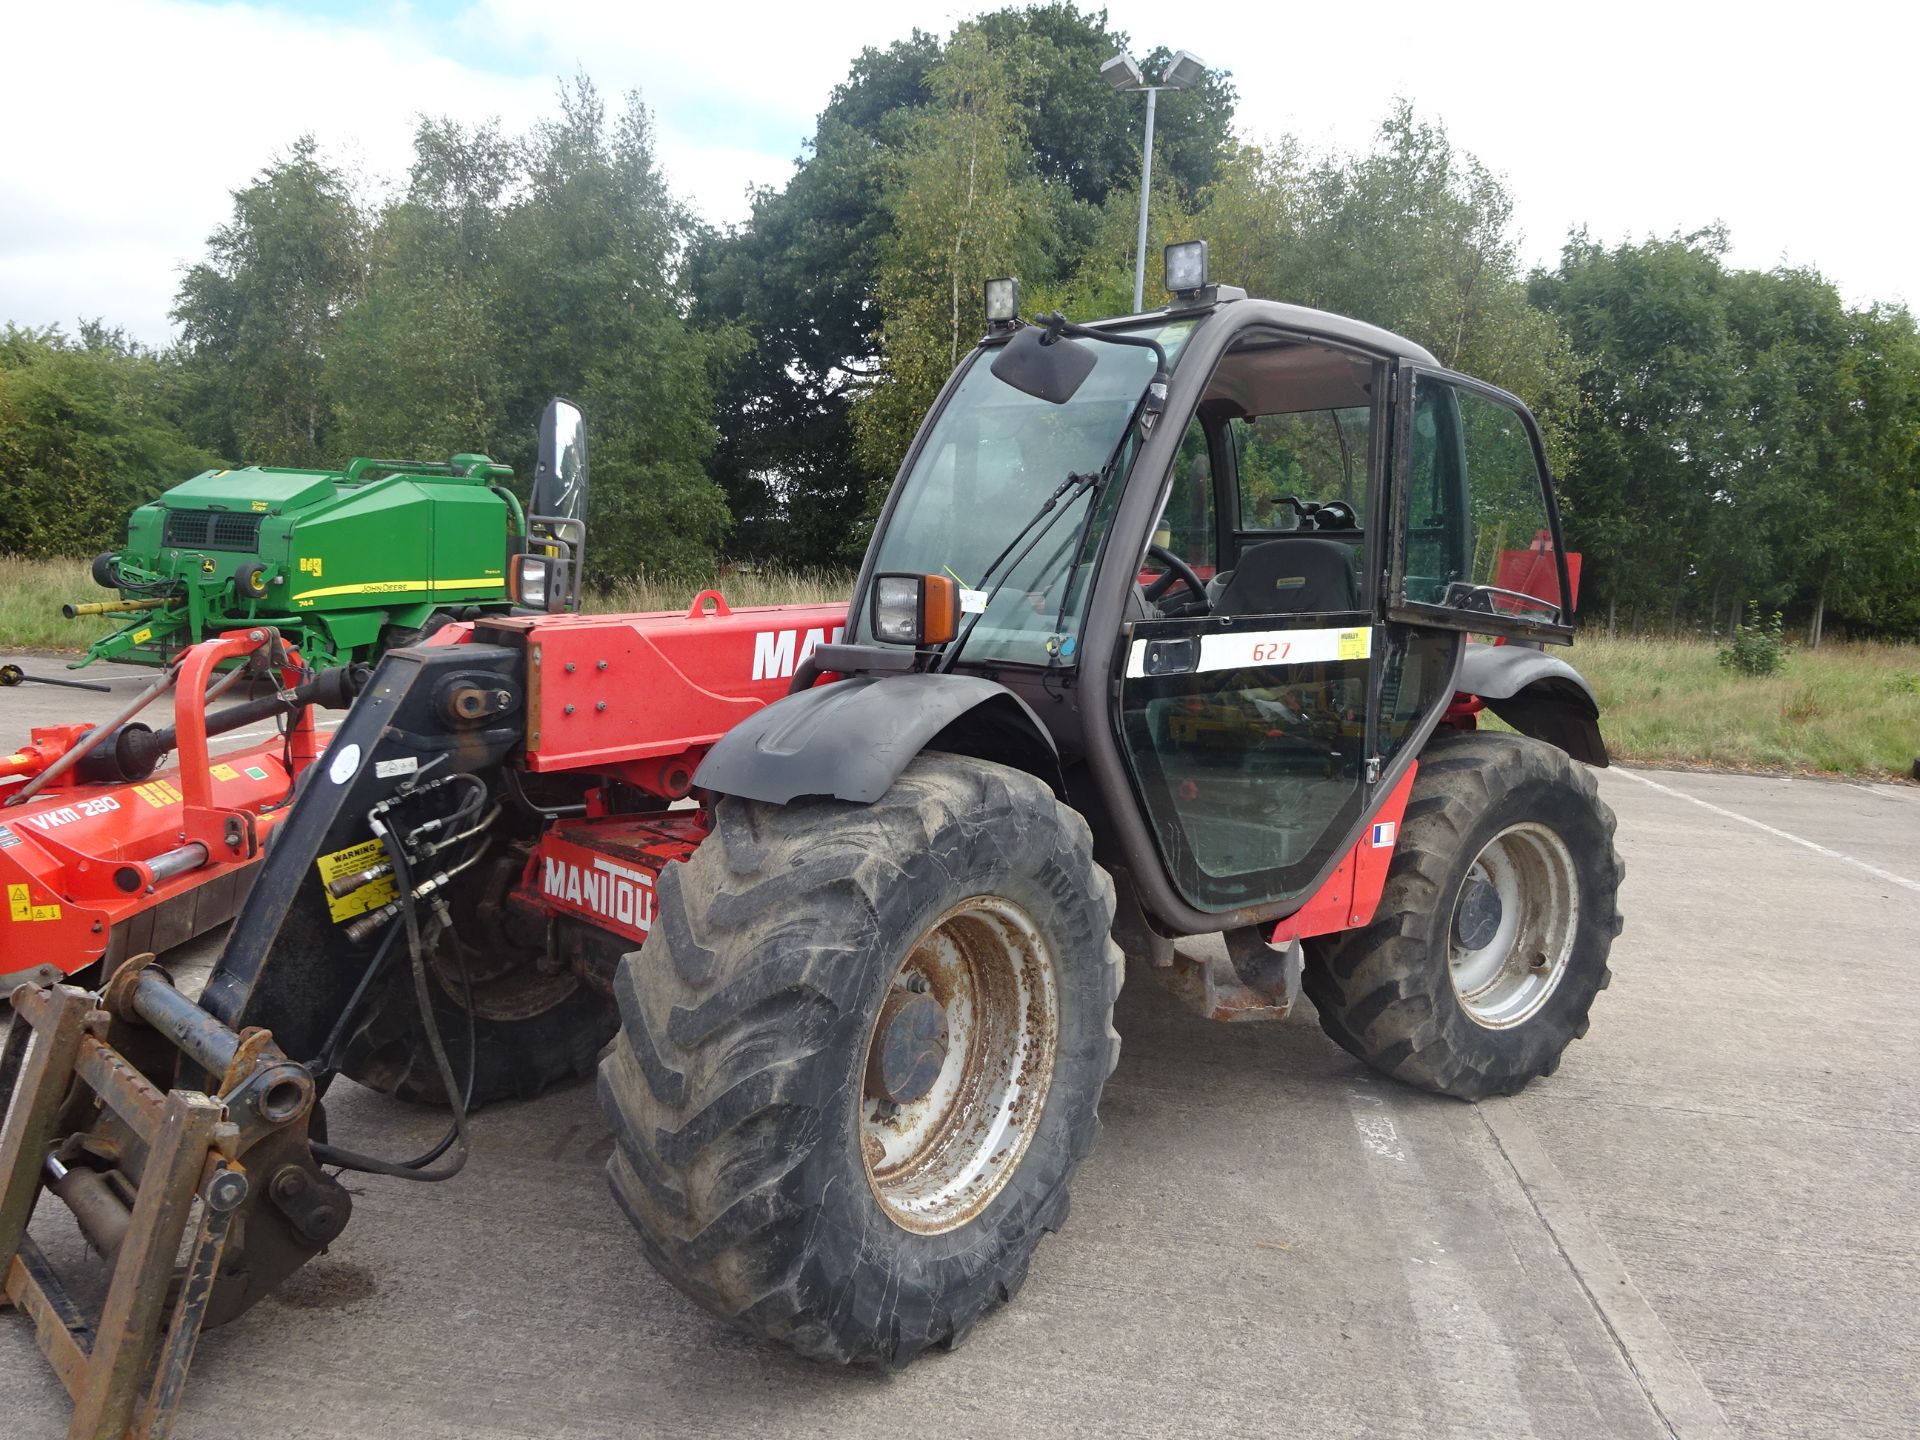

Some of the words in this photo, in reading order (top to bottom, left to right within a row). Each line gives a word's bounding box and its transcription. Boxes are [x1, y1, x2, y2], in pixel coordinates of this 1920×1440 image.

[1253, 642, 1291, 661] 627
[28, 806, 82, 830] VKM
[77, 796, 121, 817] 280
[333, 843, 376, 863] WARNING
[544, 856, 652, 932] MANITOU
